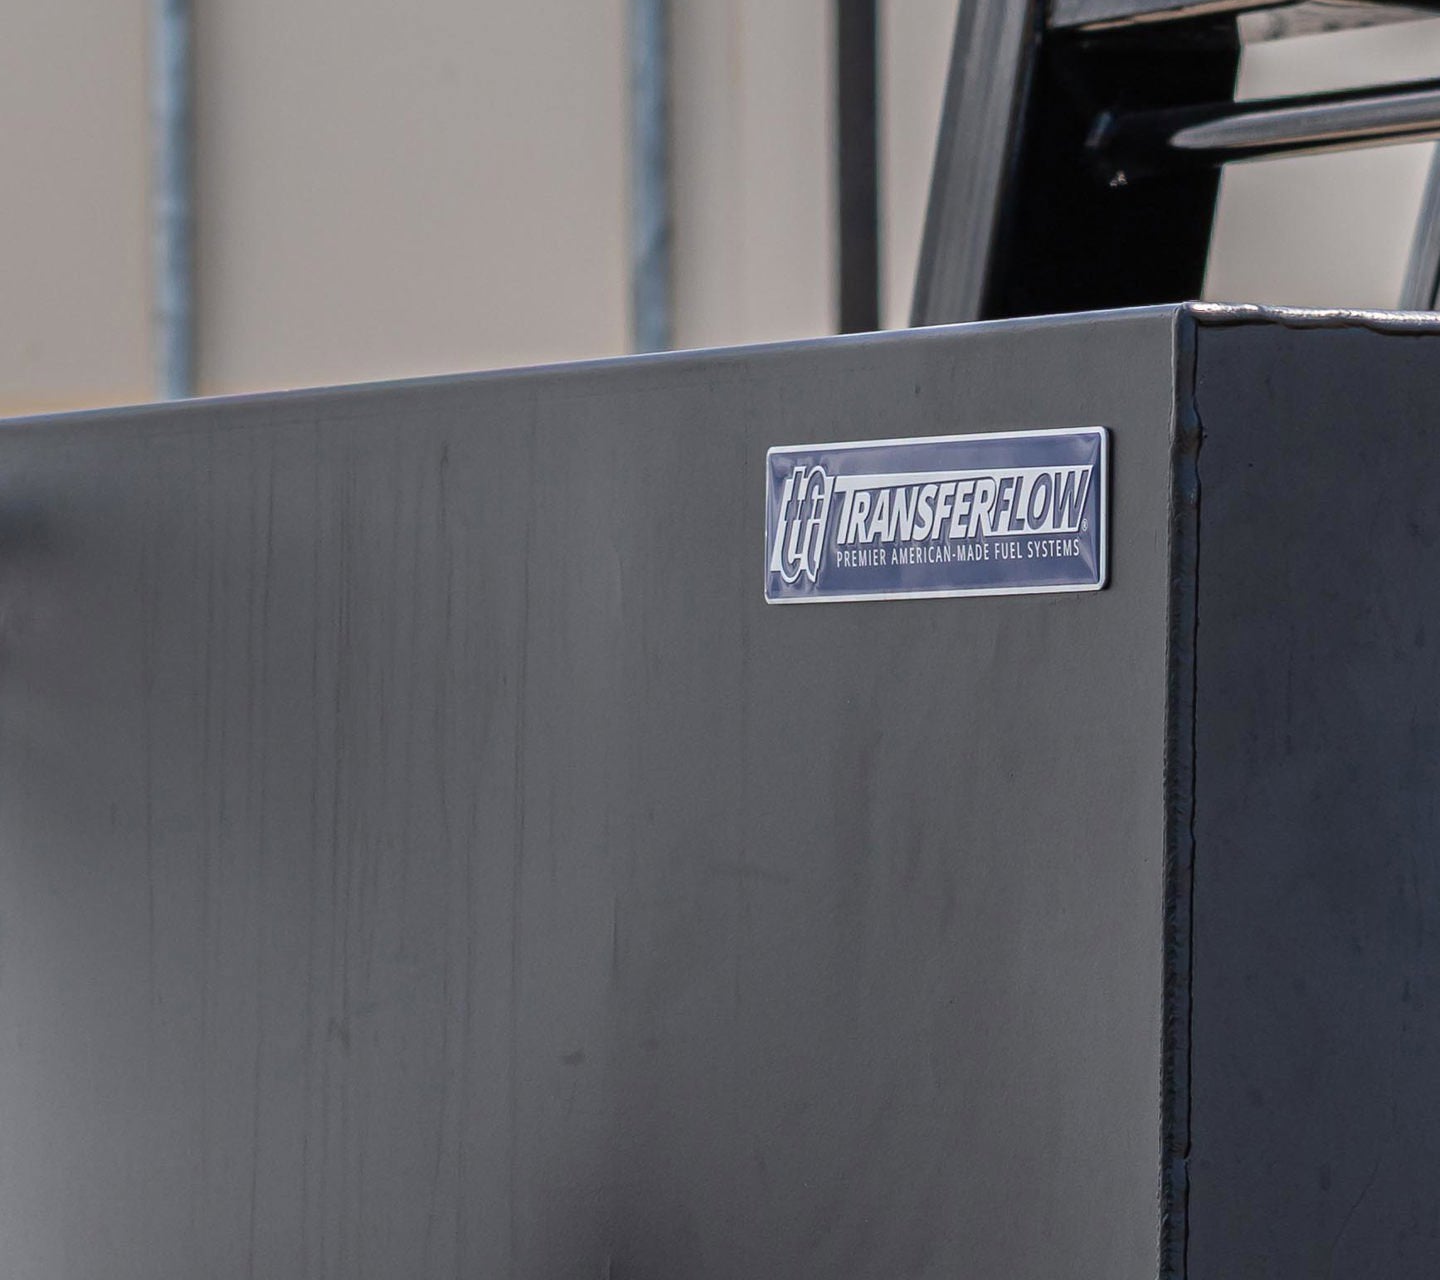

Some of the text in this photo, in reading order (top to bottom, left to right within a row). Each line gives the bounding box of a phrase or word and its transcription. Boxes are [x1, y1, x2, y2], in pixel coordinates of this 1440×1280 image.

[836, 539, 1080, 568] PREMIER AMERICAN-MADE FUEL SYSTEMS
